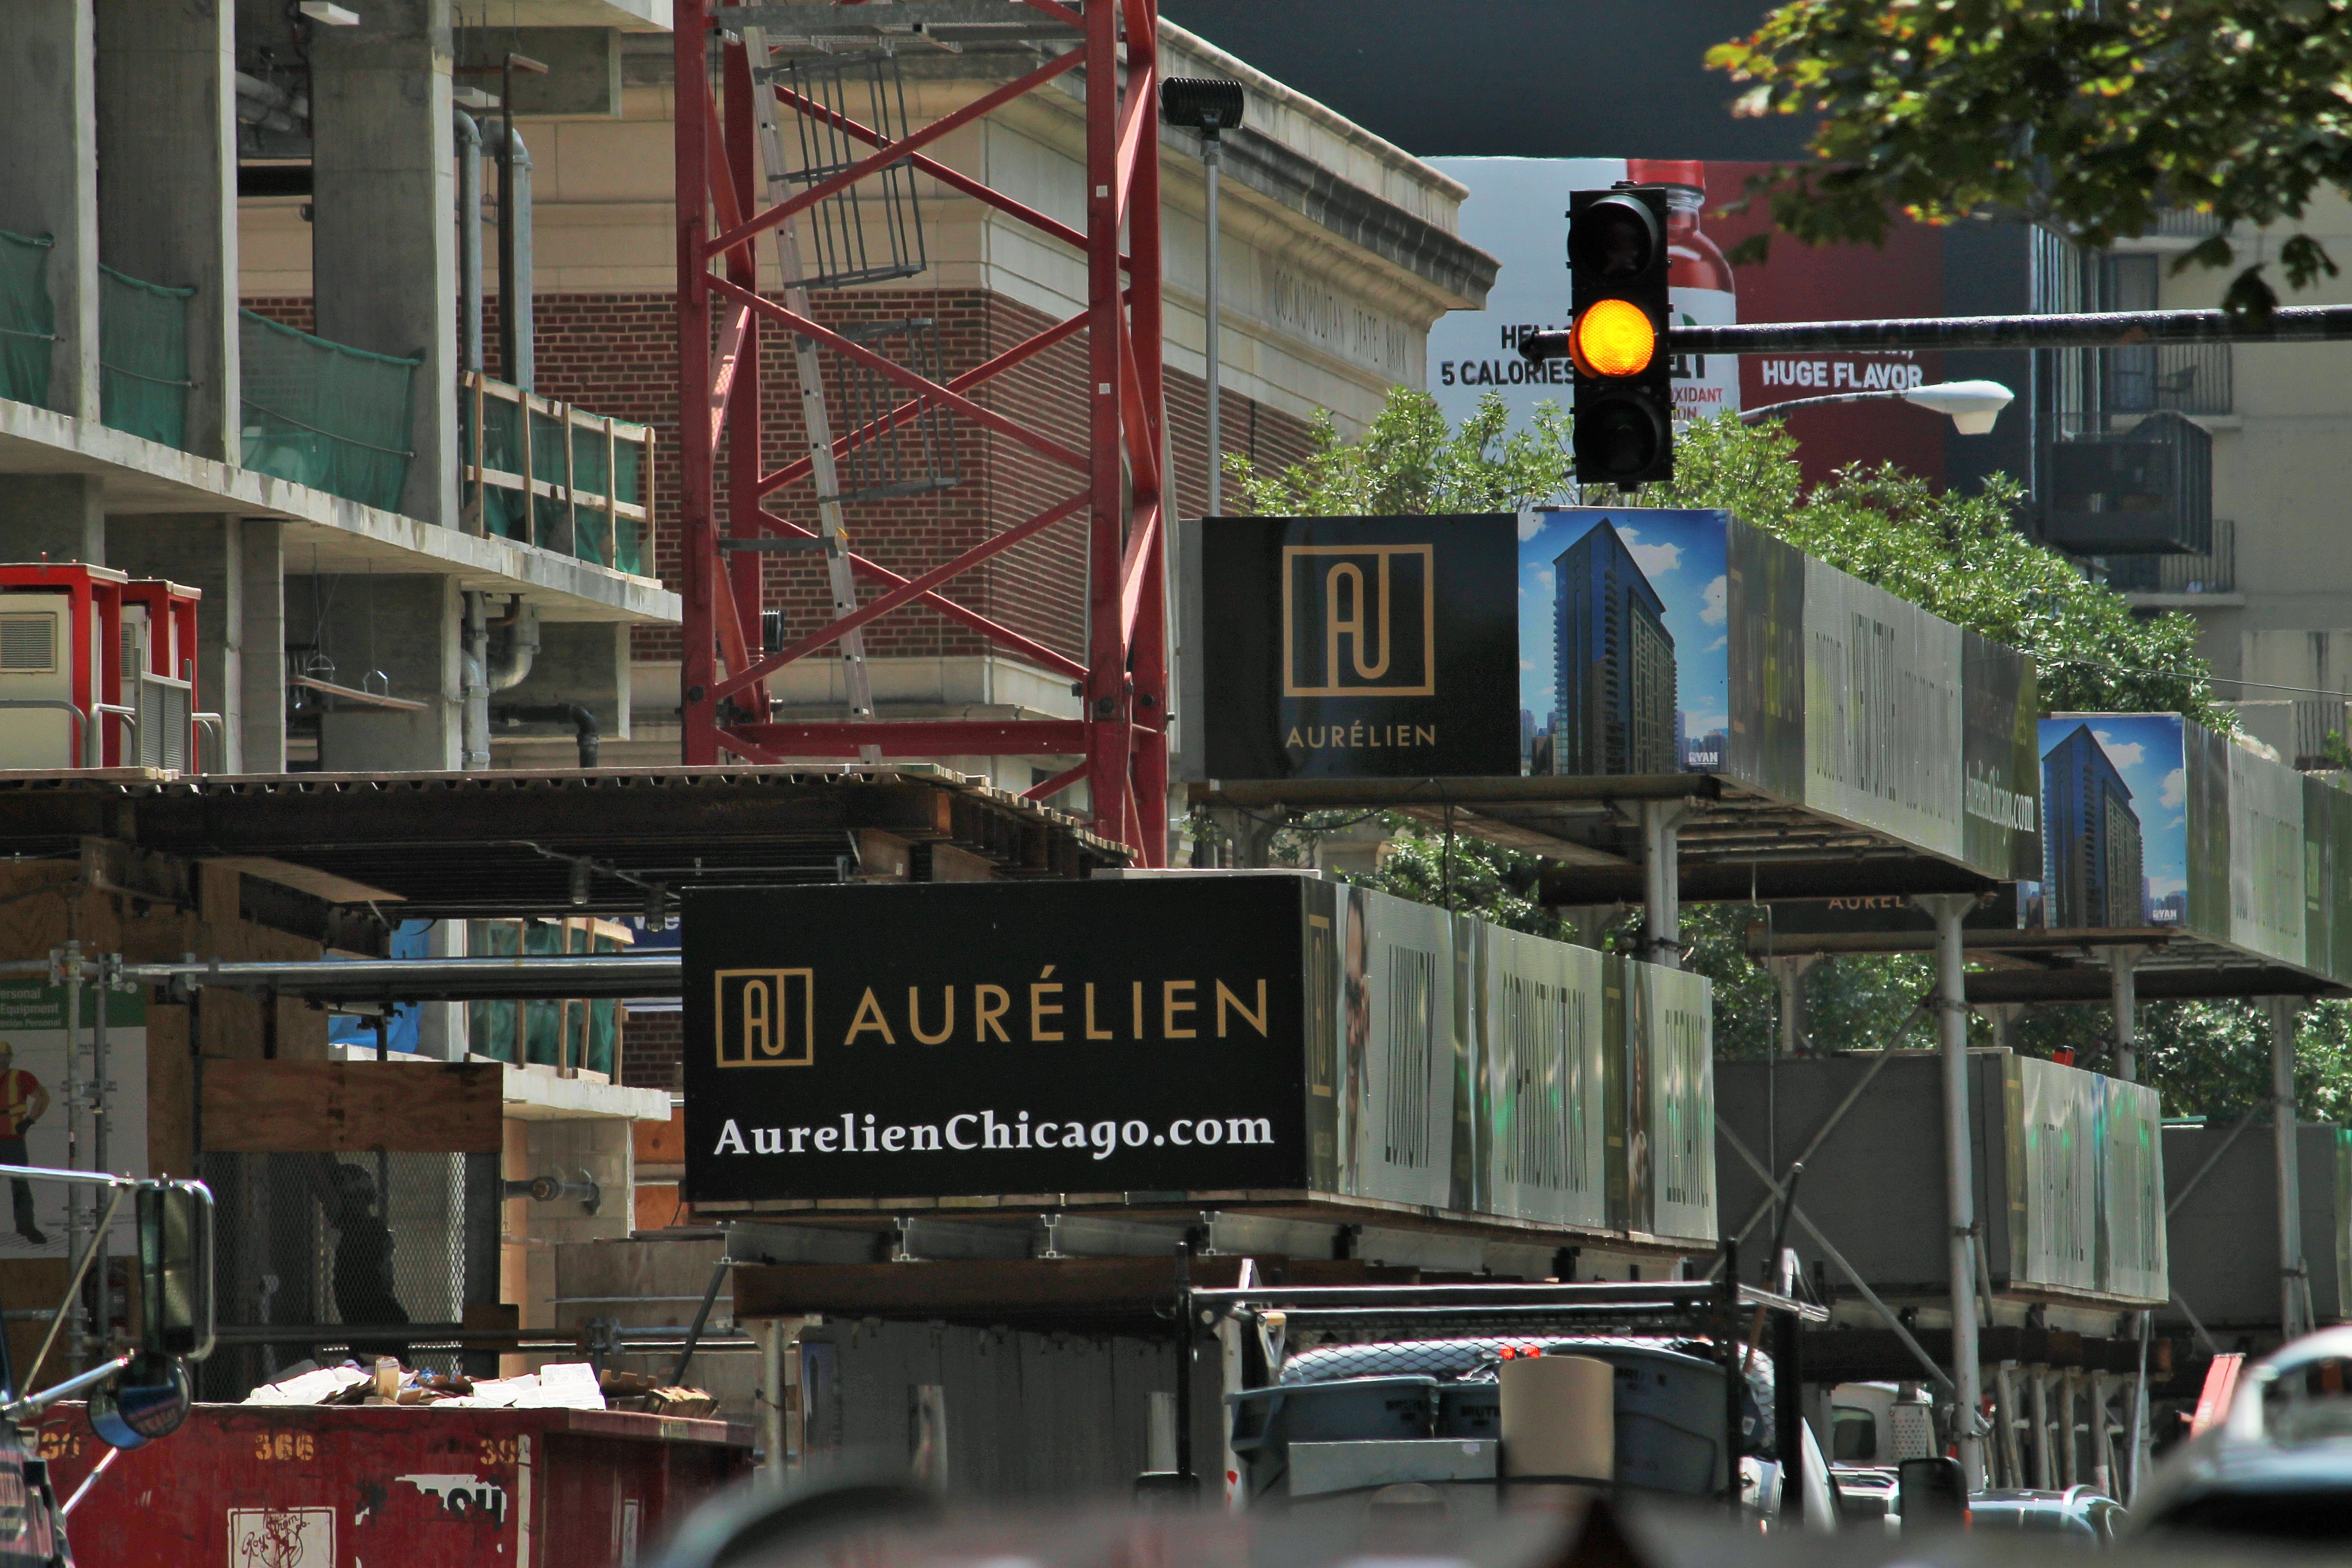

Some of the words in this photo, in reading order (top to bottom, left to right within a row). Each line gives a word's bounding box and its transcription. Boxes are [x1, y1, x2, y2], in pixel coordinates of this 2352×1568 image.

[1441, 360, 1455, 385] 5
[1762, 360, 1828, 386] HUGE
[1834, 362, 1923, 389] FLAVOR
[1285, 720, 1435, 748] AURÉLIEN
[1688, 752, 1718, 763] RYAN
[0, 988, 41, 999] ersonal
[845, 965, 1267, 1046] AURÉLIEN
[714, 1110, 1275, 1159] AurelienChicago.com
[255, 1434, 314, 1460] 366
